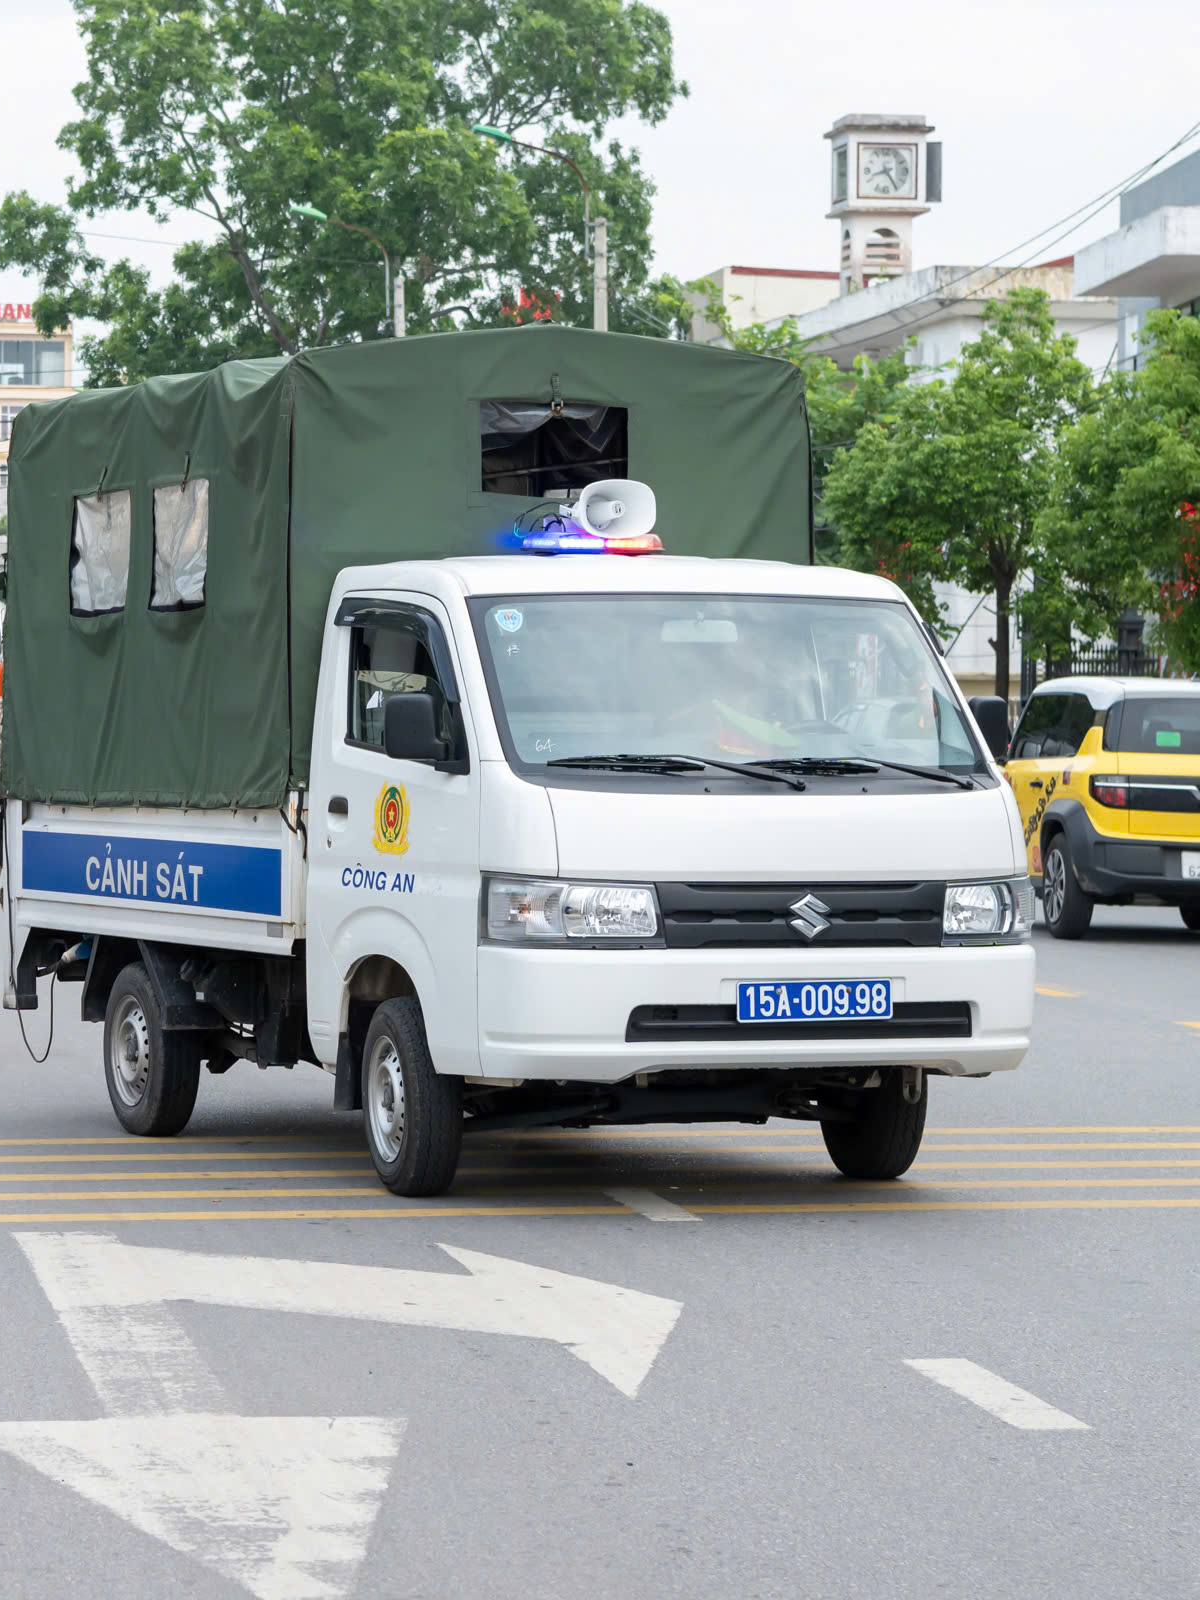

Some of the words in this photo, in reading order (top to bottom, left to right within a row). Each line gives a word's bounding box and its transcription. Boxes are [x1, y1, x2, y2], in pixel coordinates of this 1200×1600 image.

[85, 843, 147, 897] CẢNH
[155, 851, 203, 902] SÁT
[341, 862, 387, 891] CÔNG
[390, 872, 415, 893] AN
[746, 983, 887, 1018] 15A-009.98
